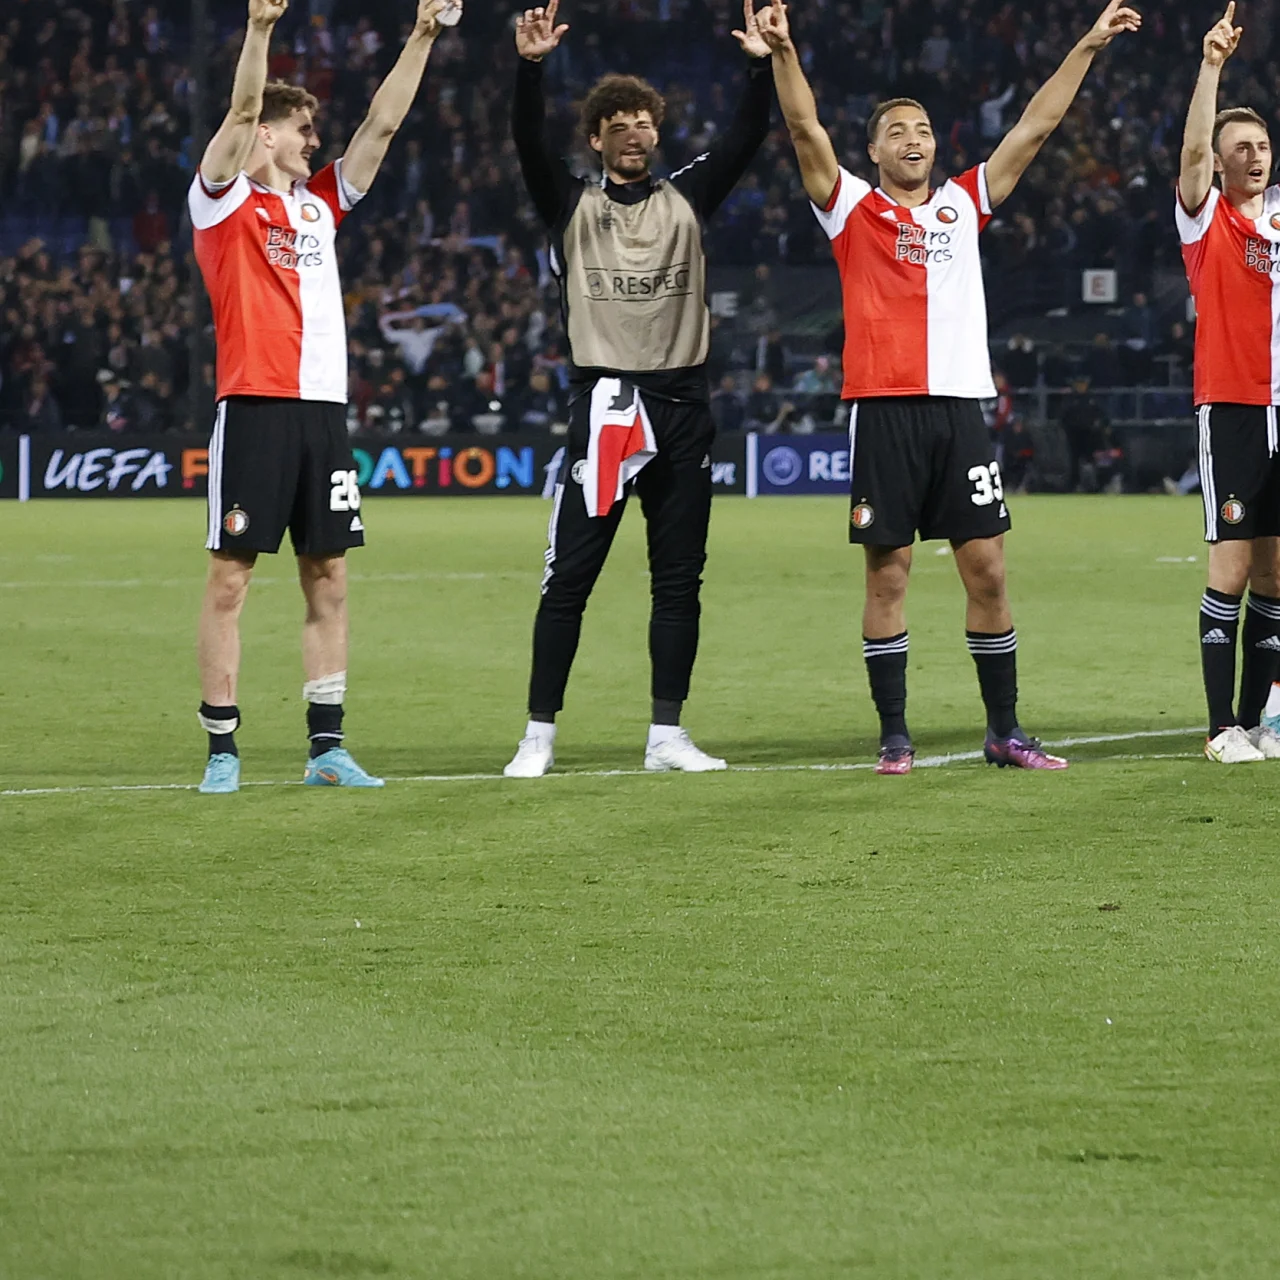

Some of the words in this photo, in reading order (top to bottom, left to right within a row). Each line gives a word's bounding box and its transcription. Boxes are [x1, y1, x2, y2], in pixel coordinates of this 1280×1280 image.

[898, 223, 951, 245] Euro
[897, 244, 953, 263] Parcs
[44, 447, 173, 492] UEFA
